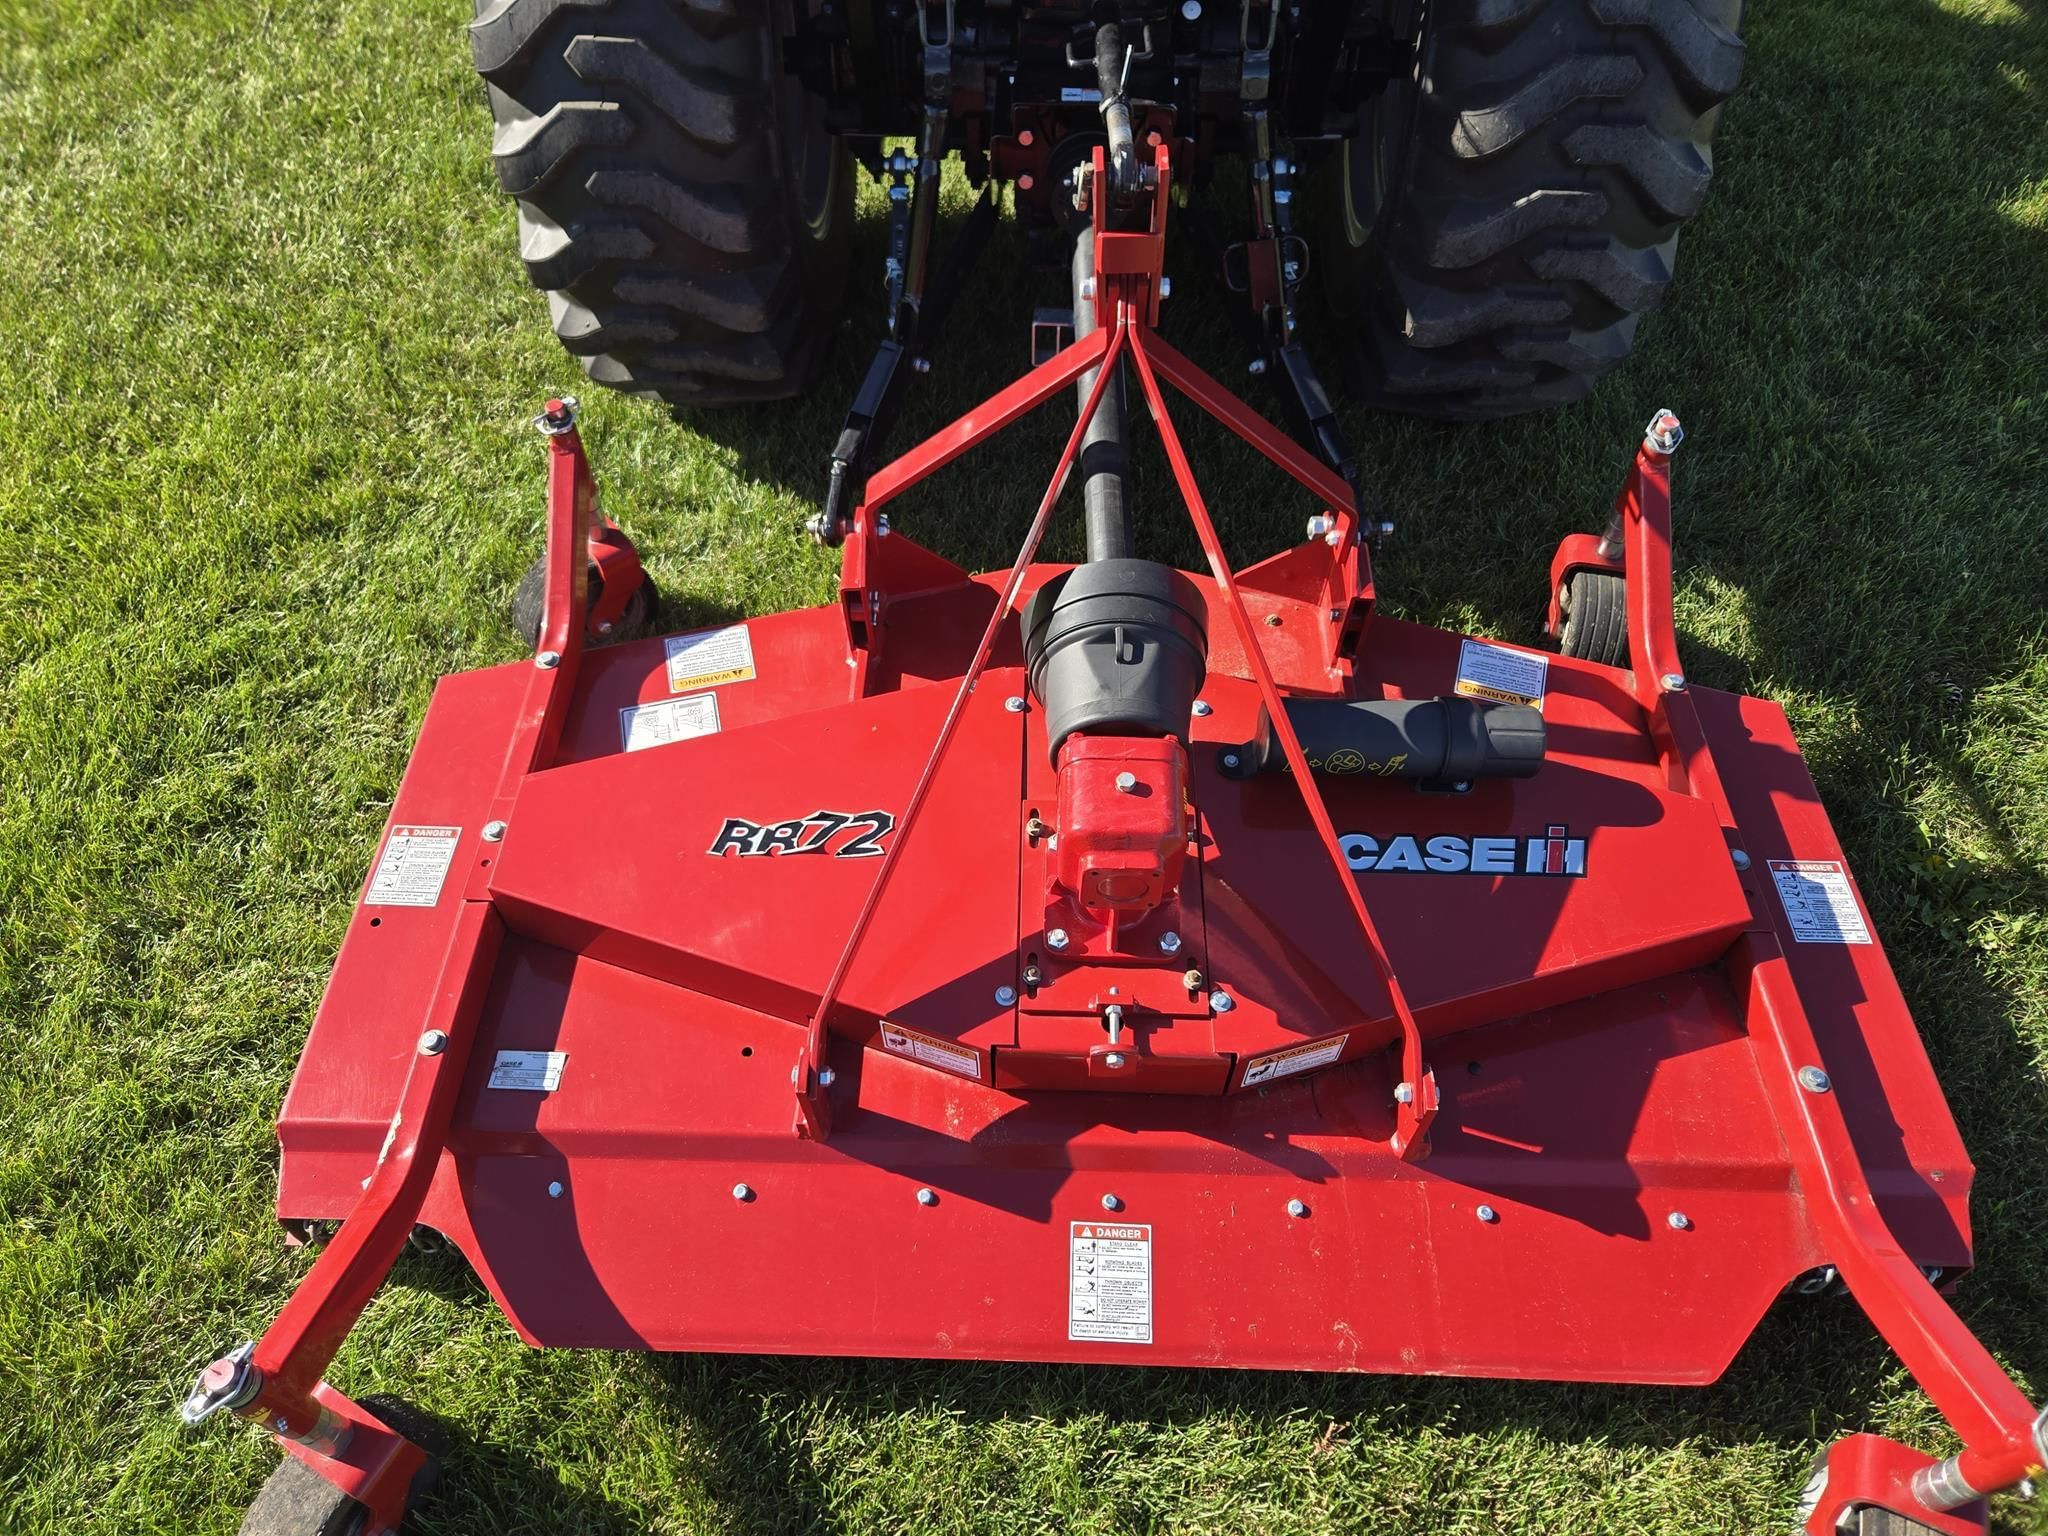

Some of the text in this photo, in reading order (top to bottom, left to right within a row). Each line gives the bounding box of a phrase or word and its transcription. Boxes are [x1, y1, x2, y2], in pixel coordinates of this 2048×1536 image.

[681, 673, 732, 687] WARNING
[1464, 685, 1517, 702] WARNING
[413, 829, 453, 838] DANGER
[705, 809, 897, 859] RR72
[1338, 834, 1516, 873] CASE
[1791, 864, 1834, 872] DANGER
[909, 1032, 970, 1057] WARNING
[1276, 1040, 1337, 1060] WARNING
[1096, 1228, 1142, 1239] DANGER
